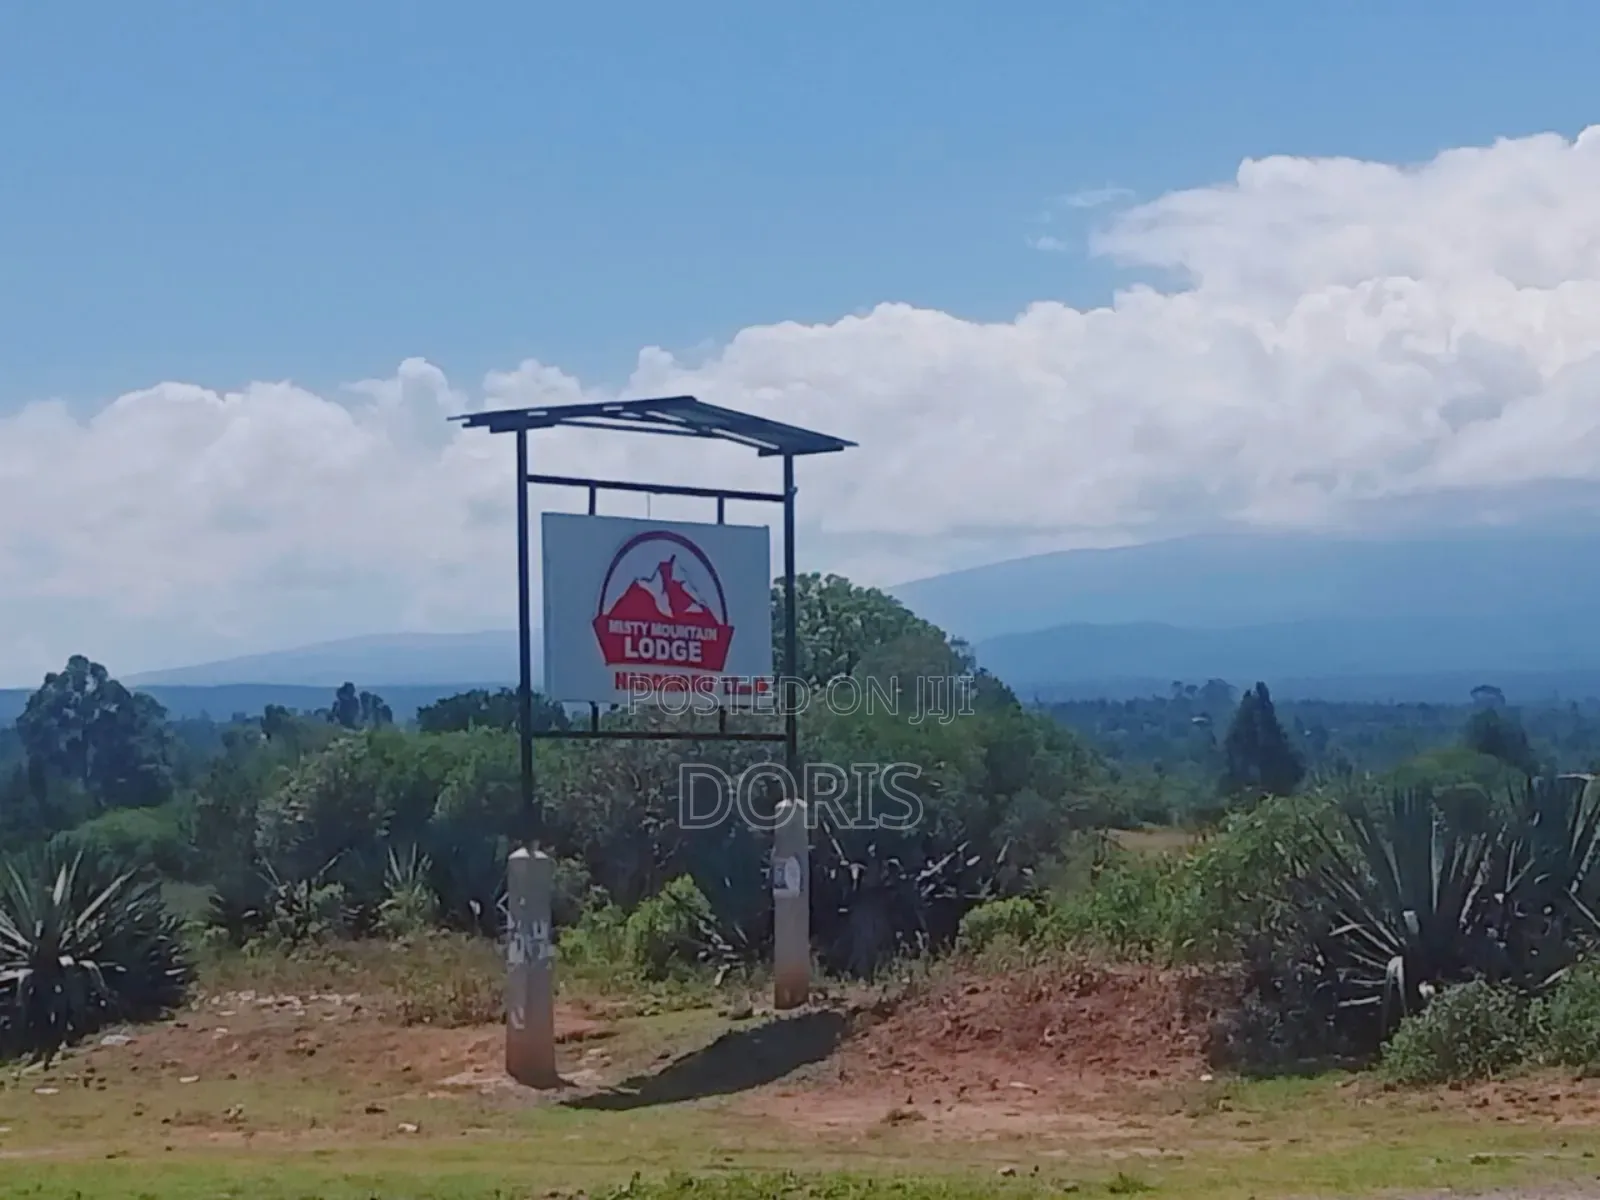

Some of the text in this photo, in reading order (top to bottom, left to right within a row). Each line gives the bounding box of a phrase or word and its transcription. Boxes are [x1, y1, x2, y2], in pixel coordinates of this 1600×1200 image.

[609, 619, 718, 641] MISTY MOUNTAIN
[624, 636, 702, 663] LODGE
